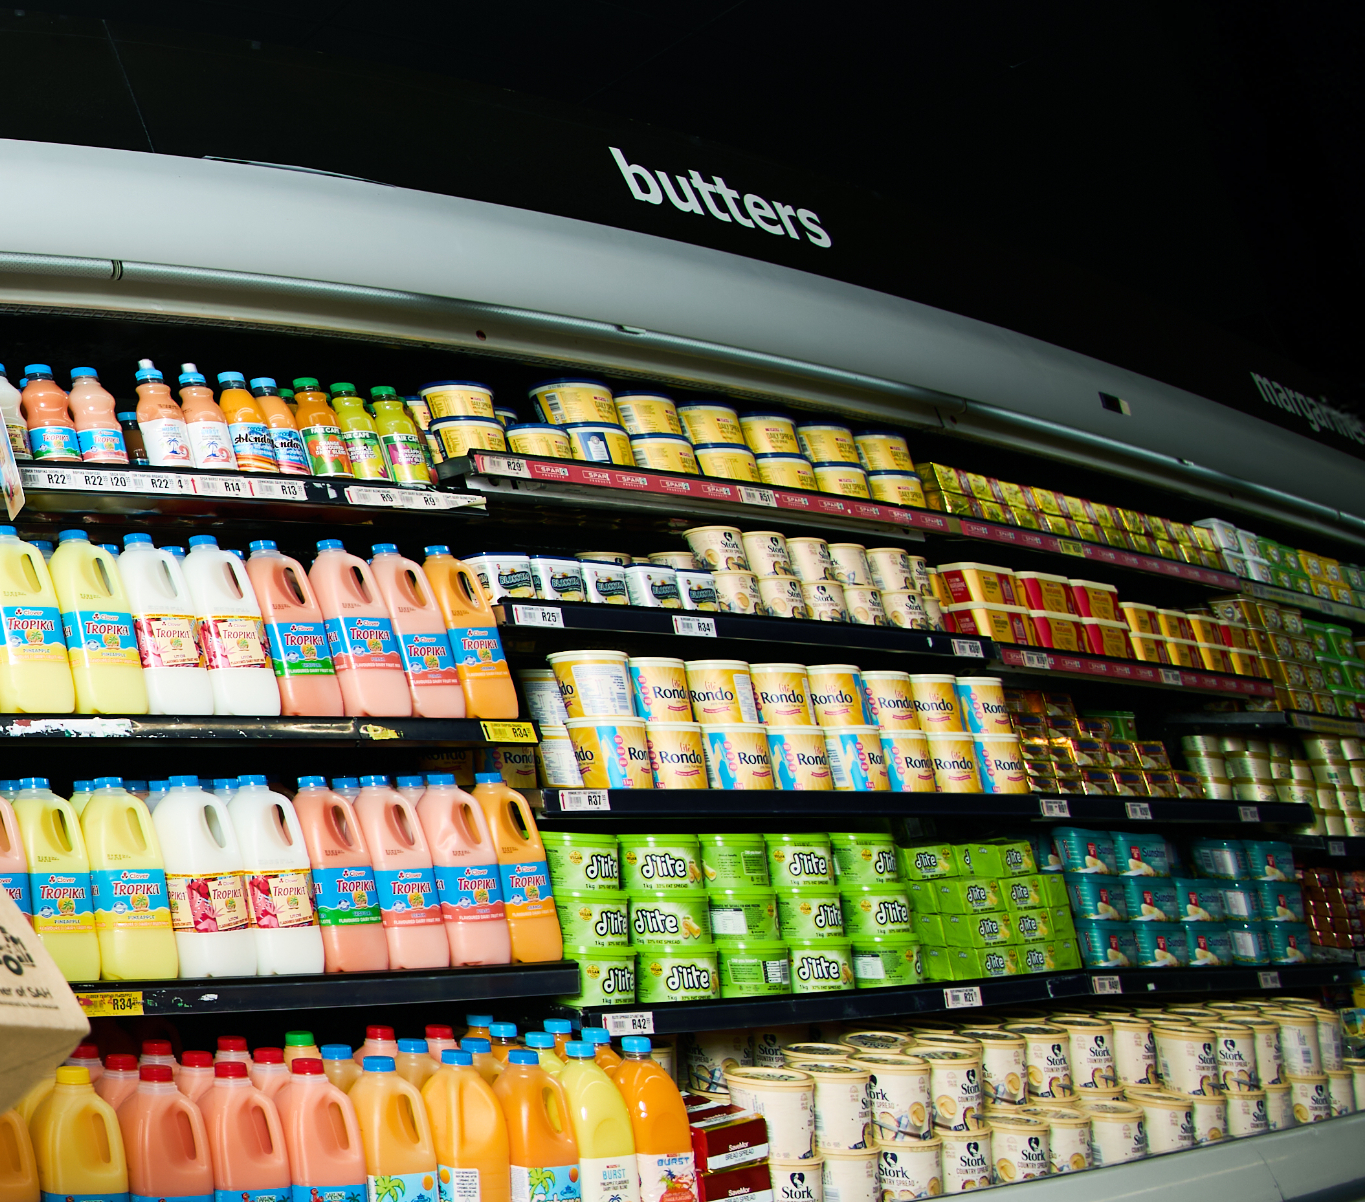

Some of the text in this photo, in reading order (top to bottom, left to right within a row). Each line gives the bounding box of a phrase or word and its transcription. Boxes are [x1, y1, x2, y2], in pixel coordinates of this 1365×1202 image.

[608, 146, 831, 248] butters
[43, 434, 69, 442] TROPIKA
[538, 466, 561, 475] SPAR
[721, 540, 740, 549] Stork
[813, 593, 835, 603] Stork
[7, 618, 54, 631] TROPIKA
[156, 628, 191, 639] TROPIKA
[351, 627, 391, 640] TROPIKA
[461, 638, 498, 650] TROPIKA
[659, 750, 702, 764] Rondo
[934, 758, 973, 770] Rondo
[641, 853, 687, 879] d'lite
[55, 876, 75, 884] Clover
[510, 875, 546, 888] TROPIKA
[40, 885, 86, 899] TROPIKA
[113, 881, 161, 896] TROPIKA
[634, 909, 679, 934] d'lite
[797, 957, 840, 980] d'lite
[16, 985, 26, 997] of
[28, 987, 52, 999] SAH
[728, 1142, 749, 1151] SaveMor
[725, 1148, 754, 1160] BREAD SPREAD
[1022, 1149, 1046, 1161] Stork
[657, 1156, 690, 1167] BURST
[960, 1156, 986, 1167] Stork
[603, 1169, 625, 1180] BURST
[782, 1186, 813, 1199] Stork
